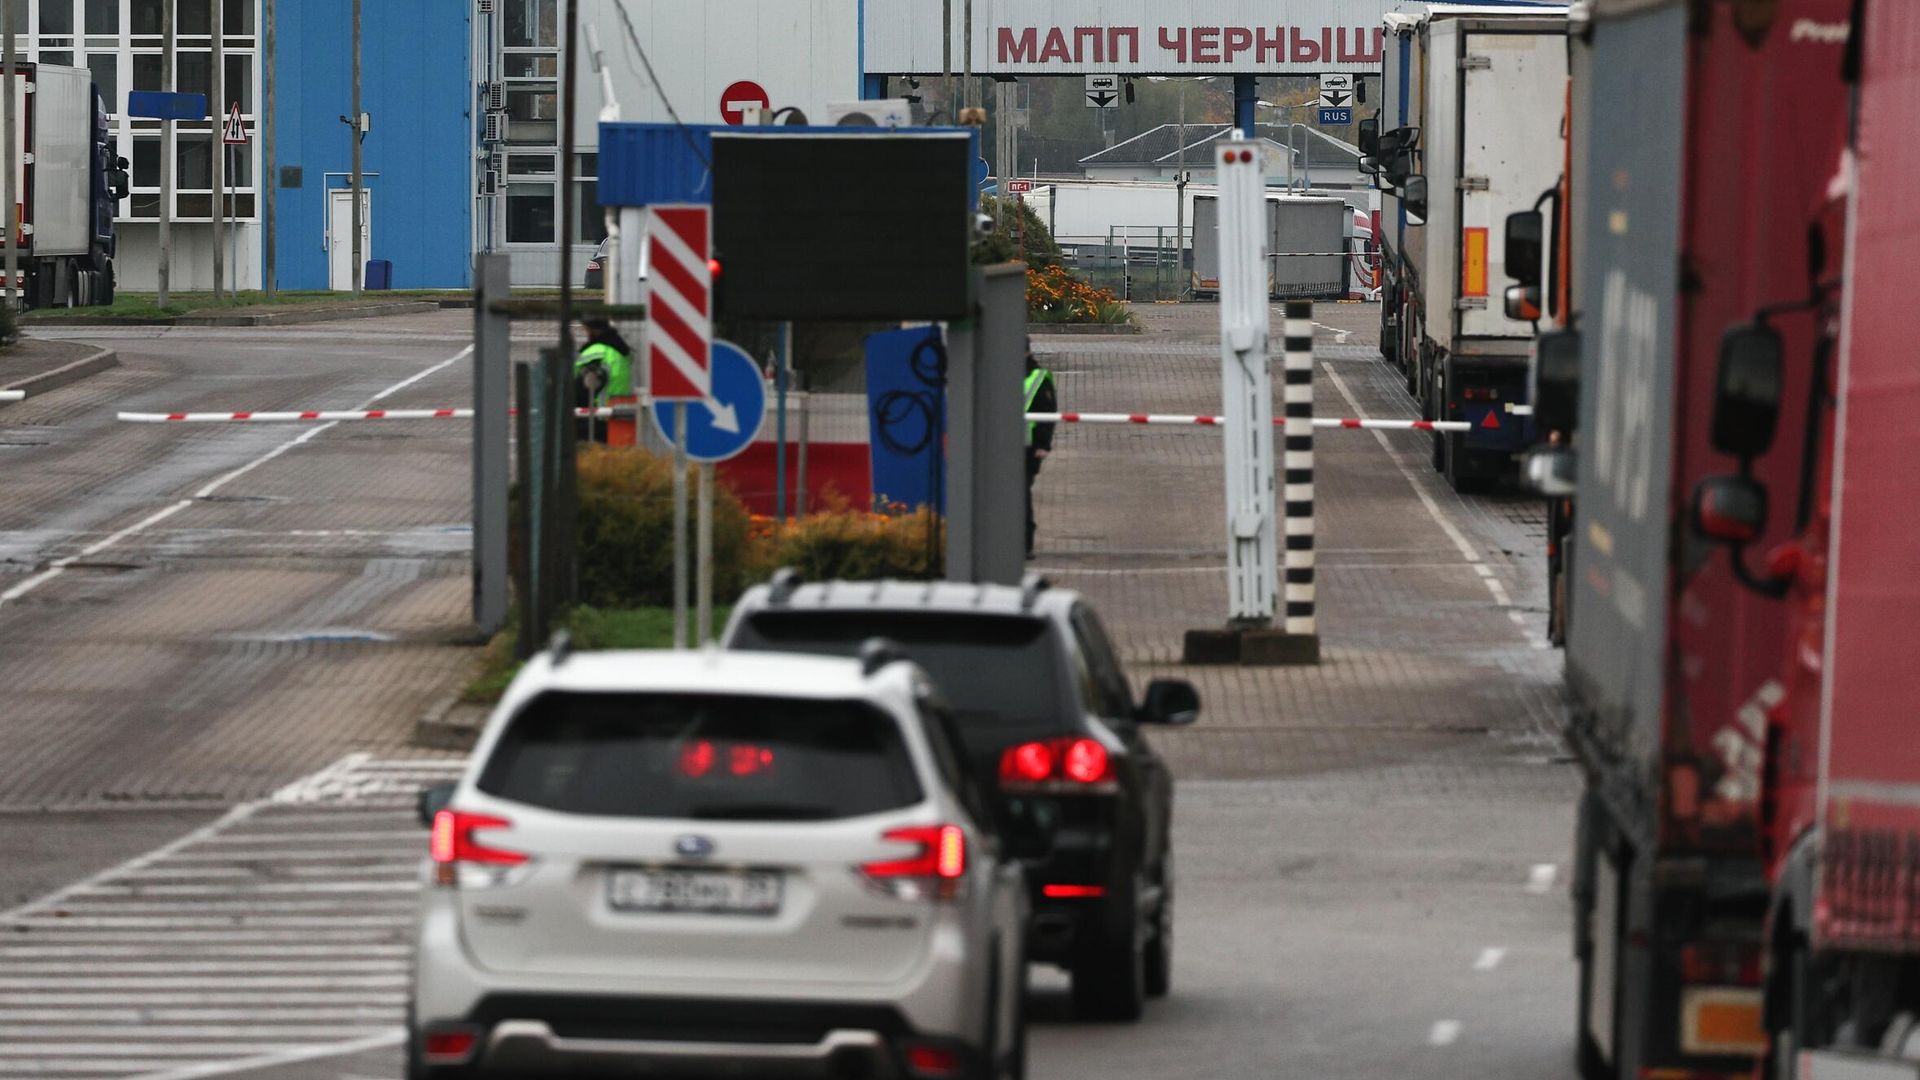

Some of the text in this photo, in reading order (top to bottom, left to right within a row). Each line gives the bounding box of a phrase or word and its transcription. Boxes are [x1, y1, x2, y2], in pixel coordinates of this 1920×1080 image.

[997, 26, 1383, 63] МАПП ЧЕРНЫШ
[1324, 111, 1347, 121] RUS
